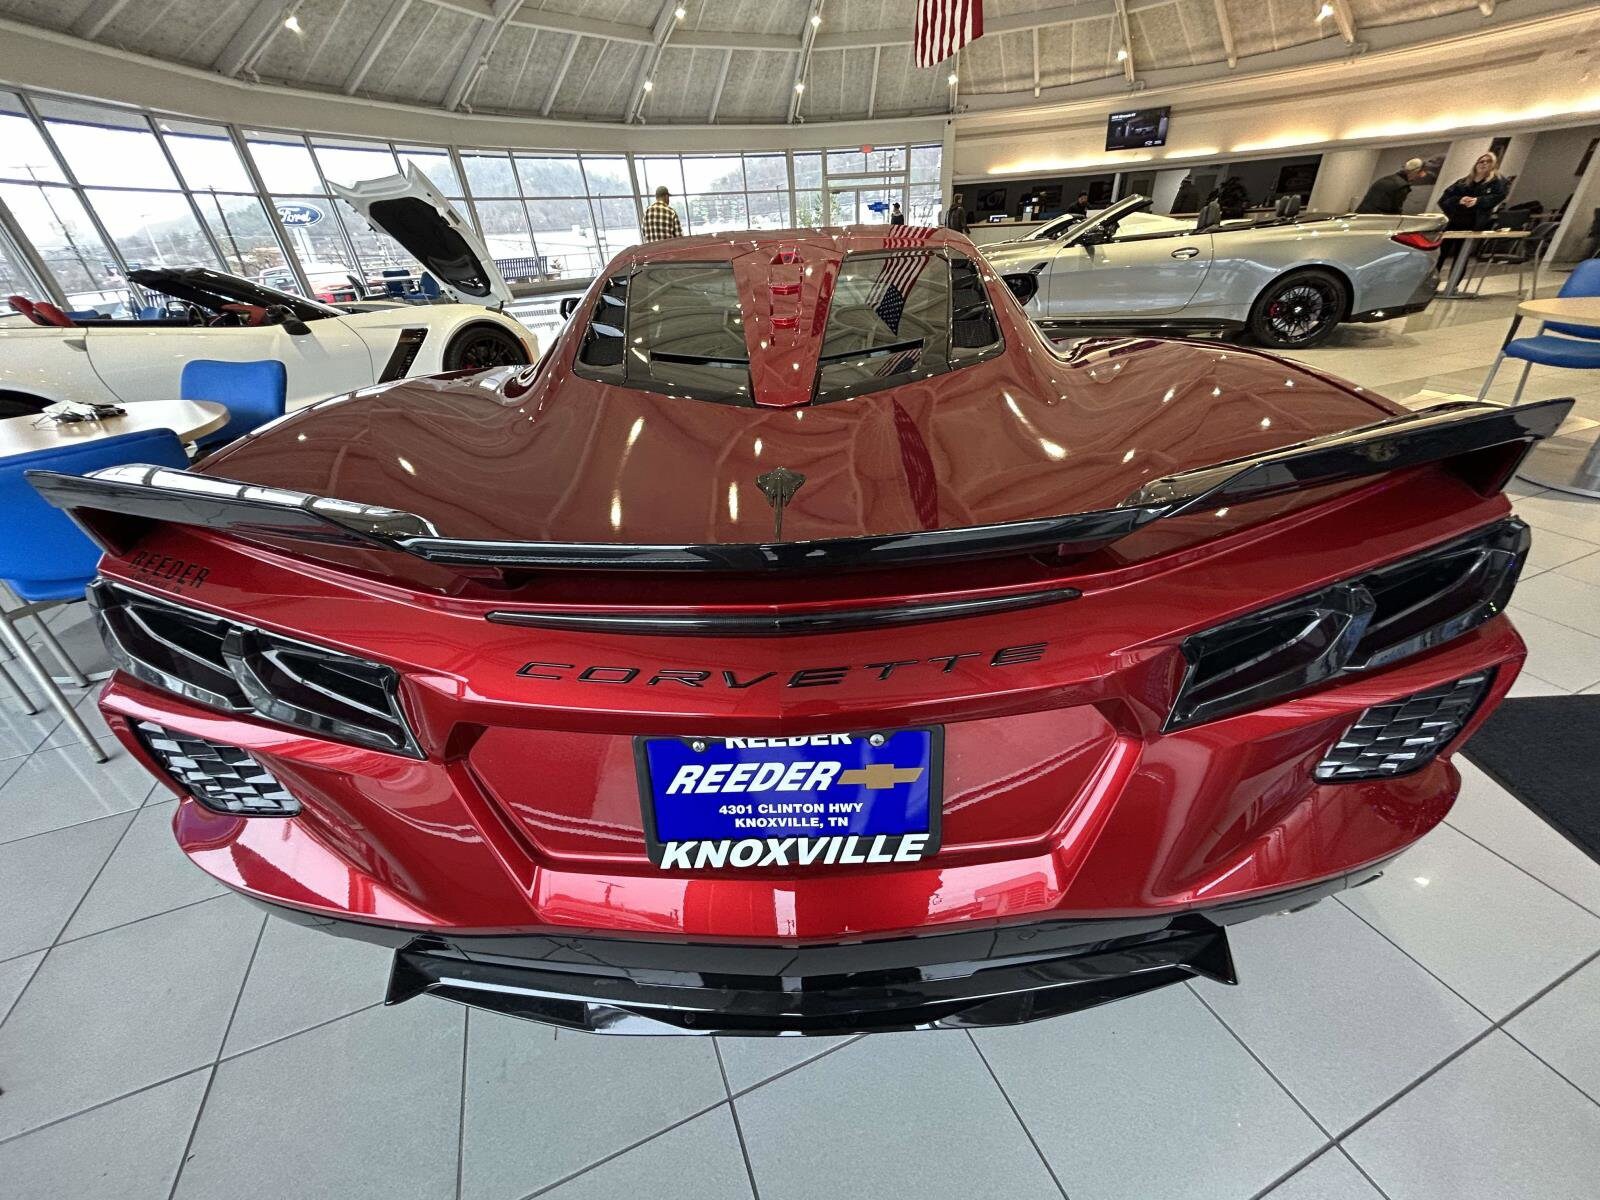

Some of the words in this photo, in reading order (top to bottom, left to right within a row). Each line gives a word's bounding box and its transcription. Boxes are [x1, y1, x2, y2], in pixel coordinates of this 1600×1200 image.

[277, 208, 311, 223] Ford
[128, 551, 209, 588] REEDER
[515, 642, 1048, 688] CORVETTE
[666, 761, 841, 795] REEDER
[719, 805, 753, 815] 4301
[758, 803, 824, 814] CLINTON
[829, 803, 863, 813] HWY
[735, 818, 824, 829] KNOXVILLE,
[828, 817, 848, 827] TN
[660, 834, 930, 870] KNOXVILLE
